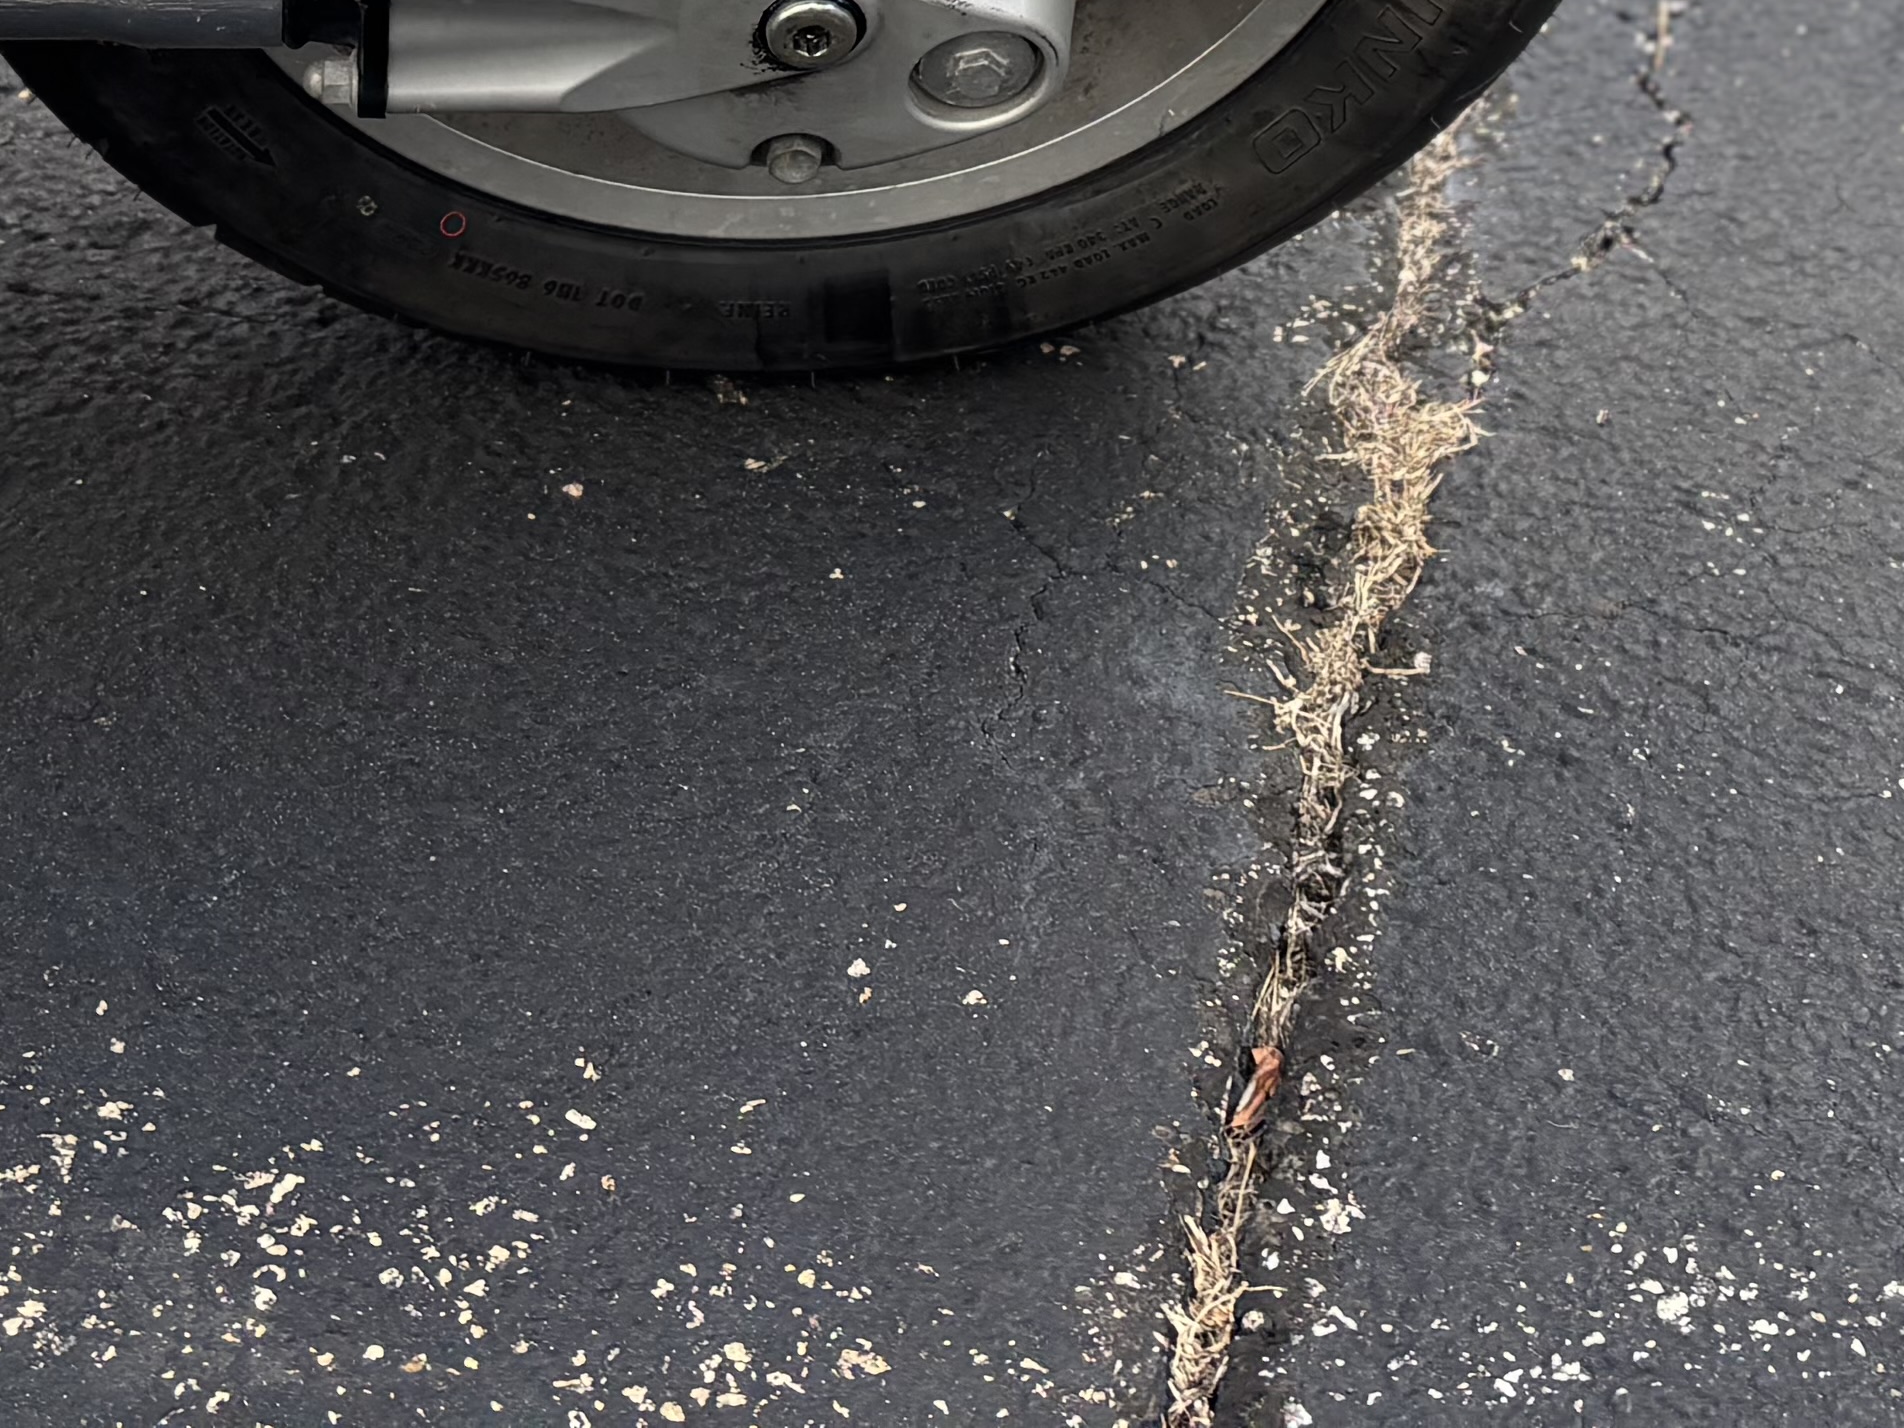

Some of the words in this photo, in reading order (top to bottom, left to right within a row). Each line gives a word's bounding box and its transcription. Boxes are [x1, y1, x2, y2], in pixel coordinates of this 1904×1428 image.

[1157, 182, 1210, 215] RANGE
[1180, 197, 1220, 223] LOAD
[594, 290, 643, 312] DOT
